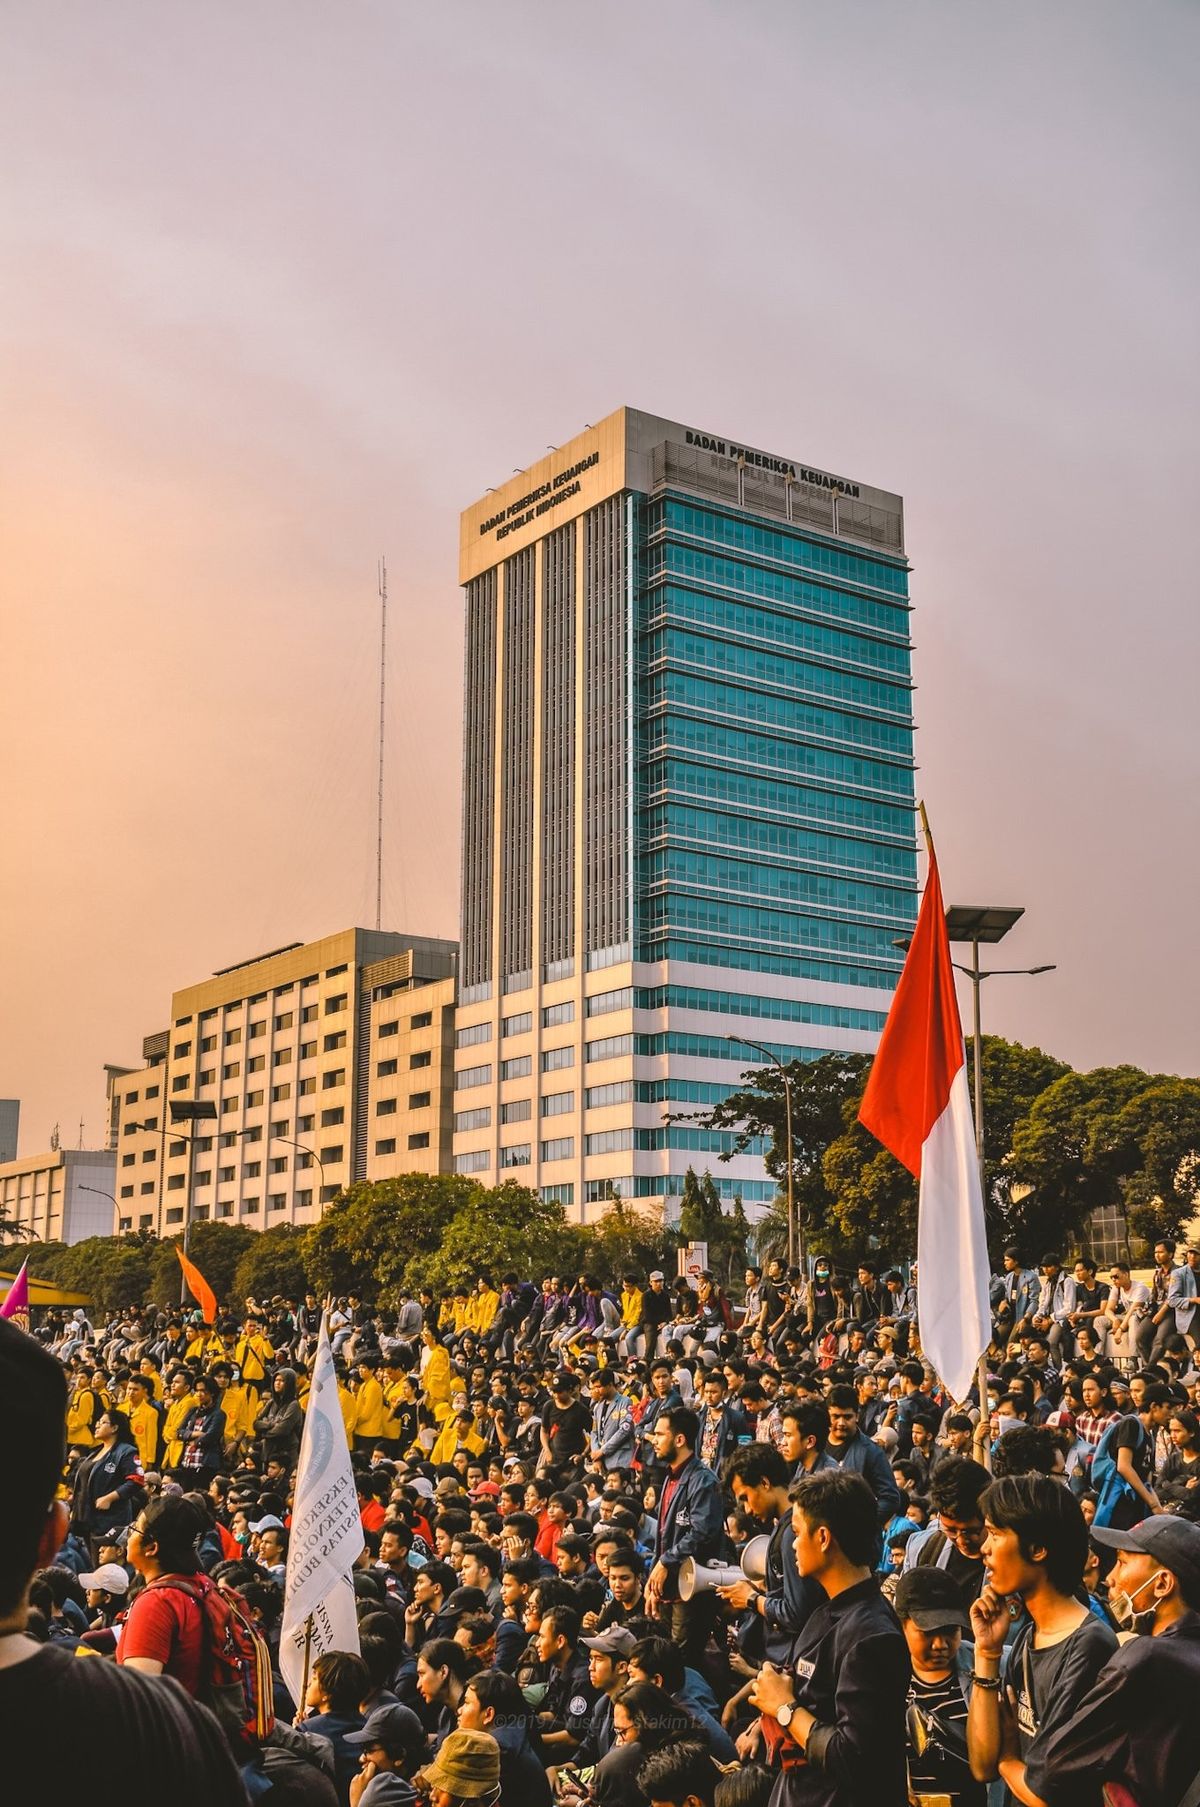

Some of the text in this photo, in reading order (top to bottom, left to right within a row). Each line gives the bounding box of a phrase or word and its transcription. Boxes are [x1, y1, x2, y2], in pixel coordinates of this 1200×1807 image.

[480, 451, 600, 536] BADAN PEMERIKSA KEUANGAN
[685, 431, 860, 498] BADAN PEMERIKSA KEUANGAN
[496, 481, 582, 541] REPUBLIK INDONESIA
